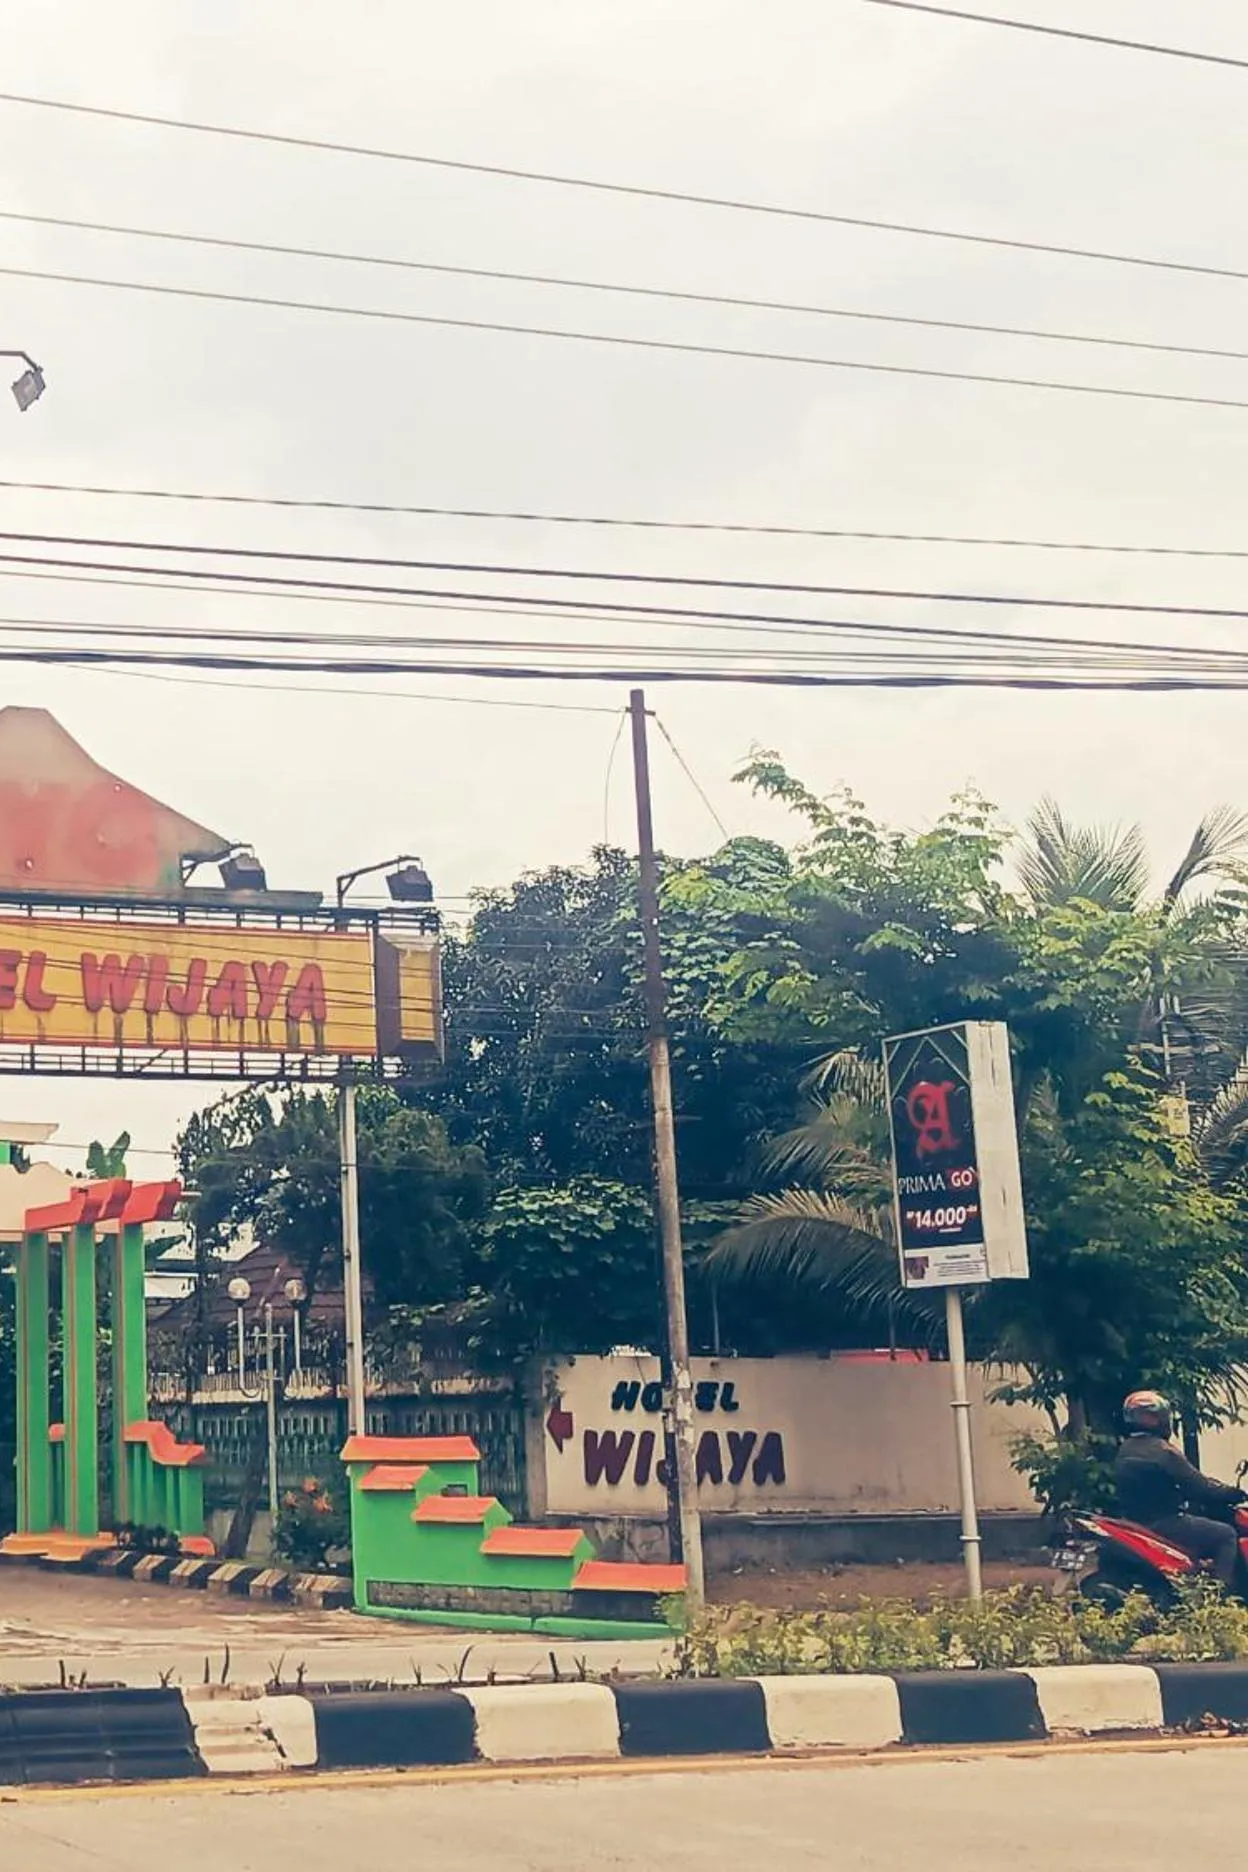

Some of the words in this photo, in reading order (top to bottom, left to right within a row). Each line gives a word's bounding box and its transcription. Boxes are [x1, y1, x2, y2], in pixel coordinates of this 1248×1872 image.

[81, 952, 326, 1021] WIJAYA
[898, 1173, 946, 1195] PRIMA
[950, 1169, 973, 1187] GO
[611, 1381, 739, 1412] HOEL
